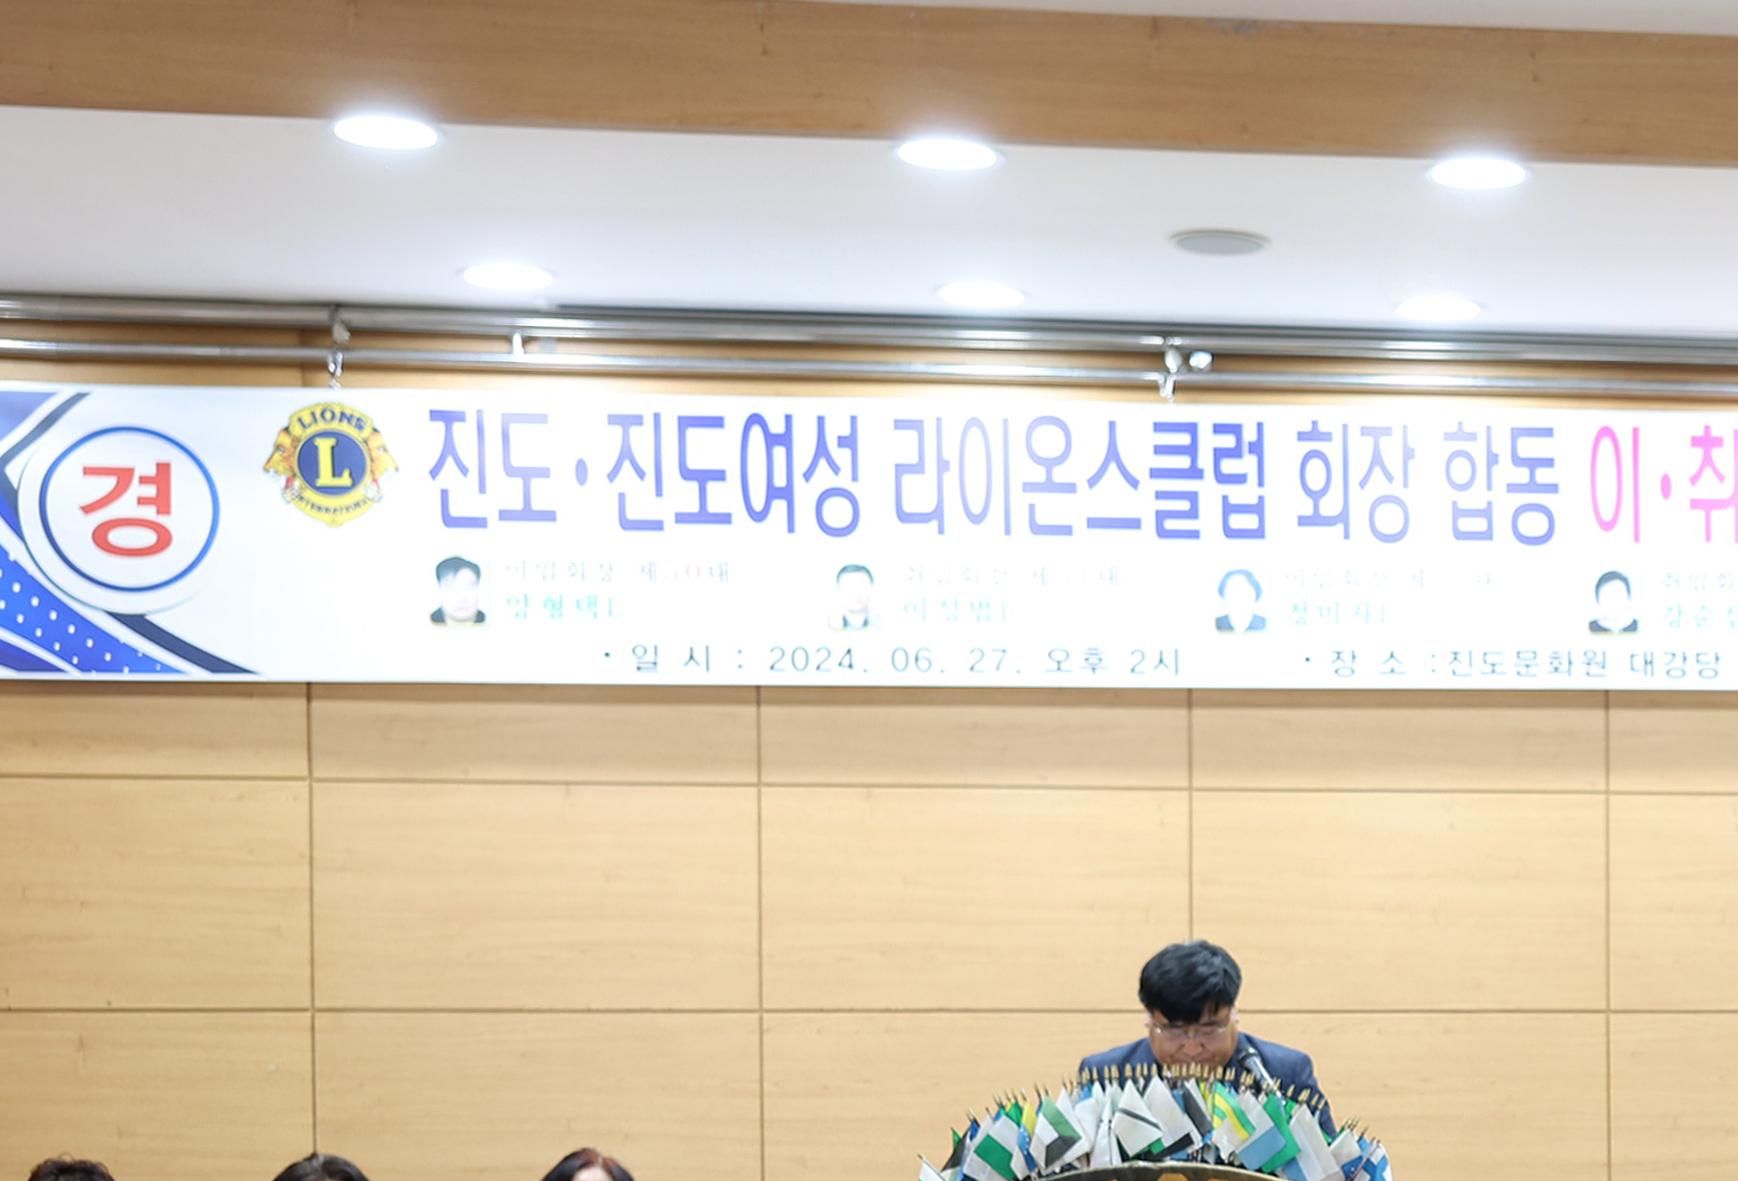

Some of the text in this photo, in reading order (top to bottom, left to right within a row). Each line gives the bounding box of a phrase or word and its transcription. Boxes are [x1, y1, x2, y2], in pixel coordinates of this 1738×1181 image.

[297, 406, 366, 432] LIONS
[314, 436, 354, 488] L
[892, 414, 1267, 542] 라이온스클럽
[1295, 419, 1416, 545] 회장
[1443, 420, 1561, 547] 합동
[80, 462, 172, 557] 경
[768, 645, 869, 674] 2024.
[890, 646, 946, 674] 06.
[968, 646, 1022, 675] 27.
[1045, 646, 1107, 676] 오후
[1129, 648, 1180, 677] 2시
[1629, 650, 1722, 680] 대강당
